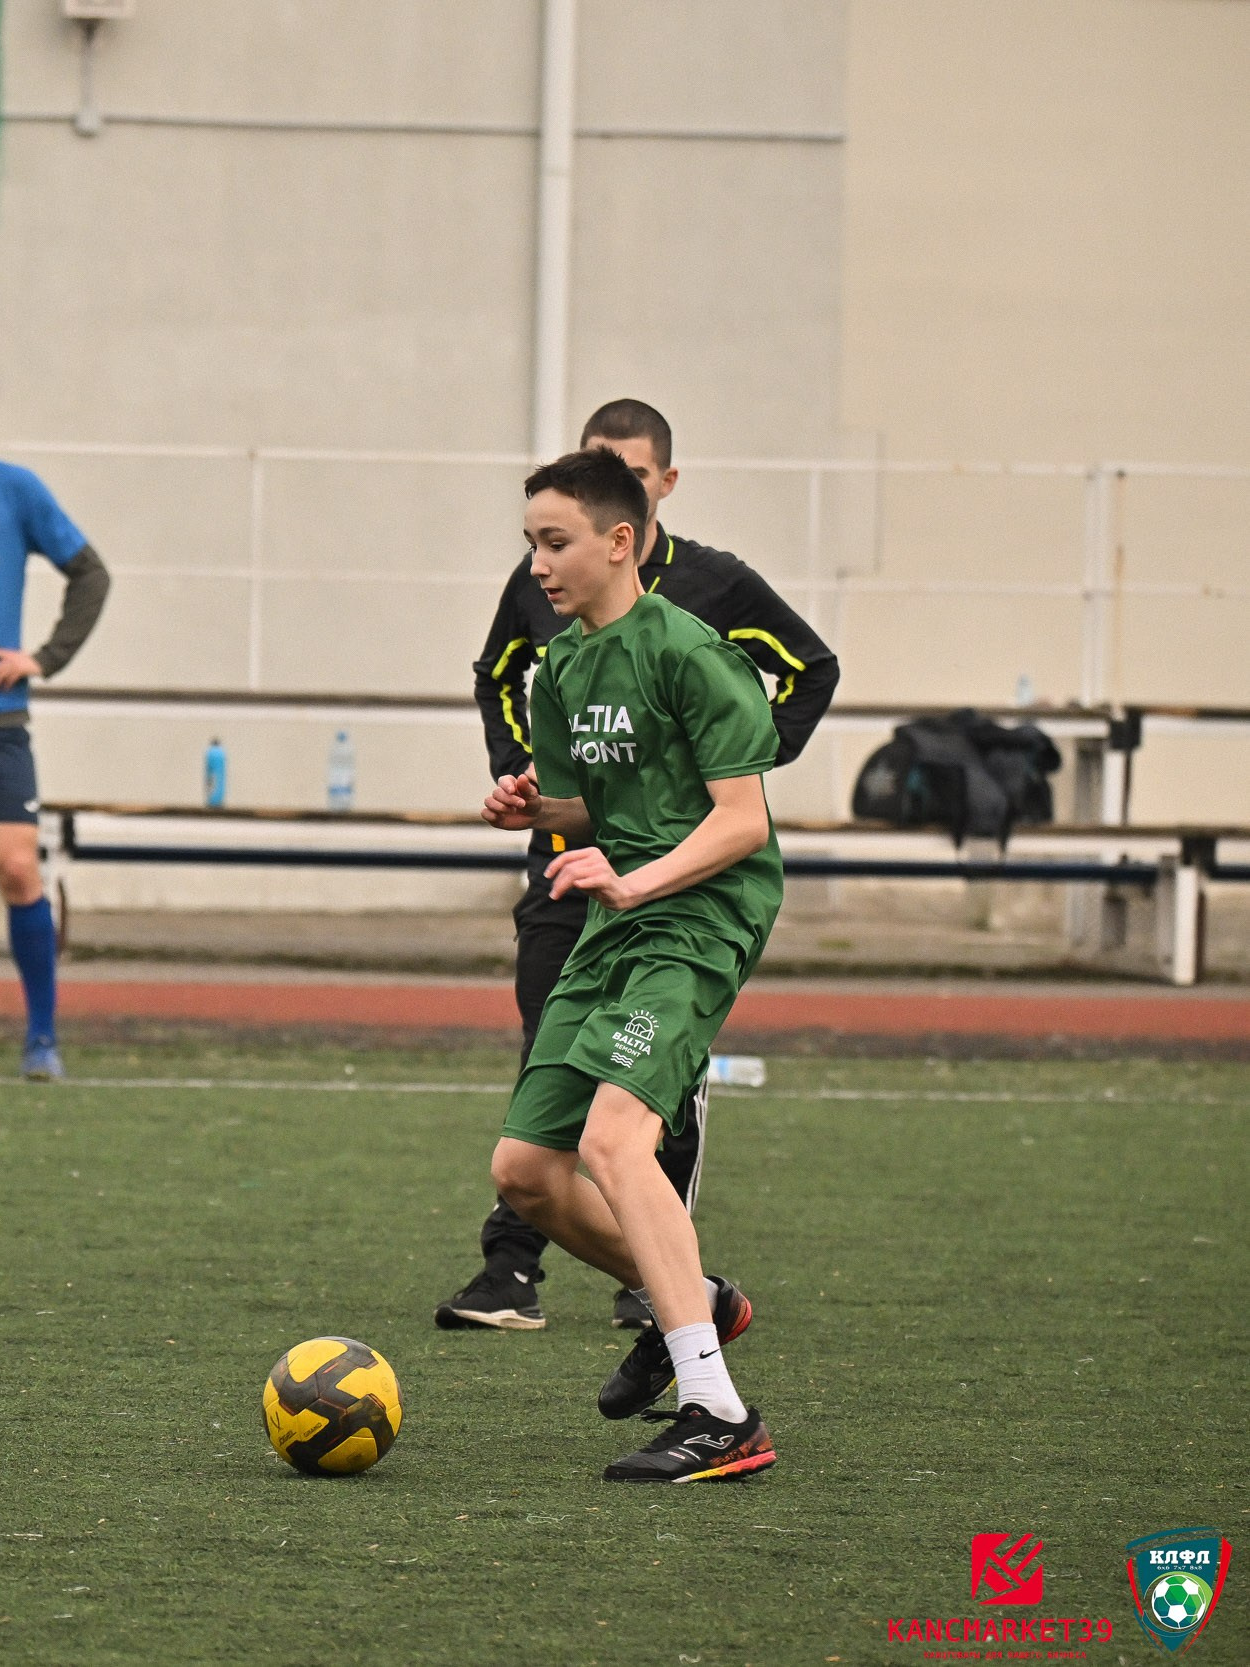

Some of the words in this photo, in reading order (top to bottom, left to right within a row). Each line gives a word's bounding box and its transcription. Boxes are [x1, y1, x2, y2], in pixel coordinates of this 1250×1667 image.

[568, 705, 634, 734] LTIA
[612, 1031, 652, 1056] BALTIA
[615, 1042, 642, 1058] REMONT
